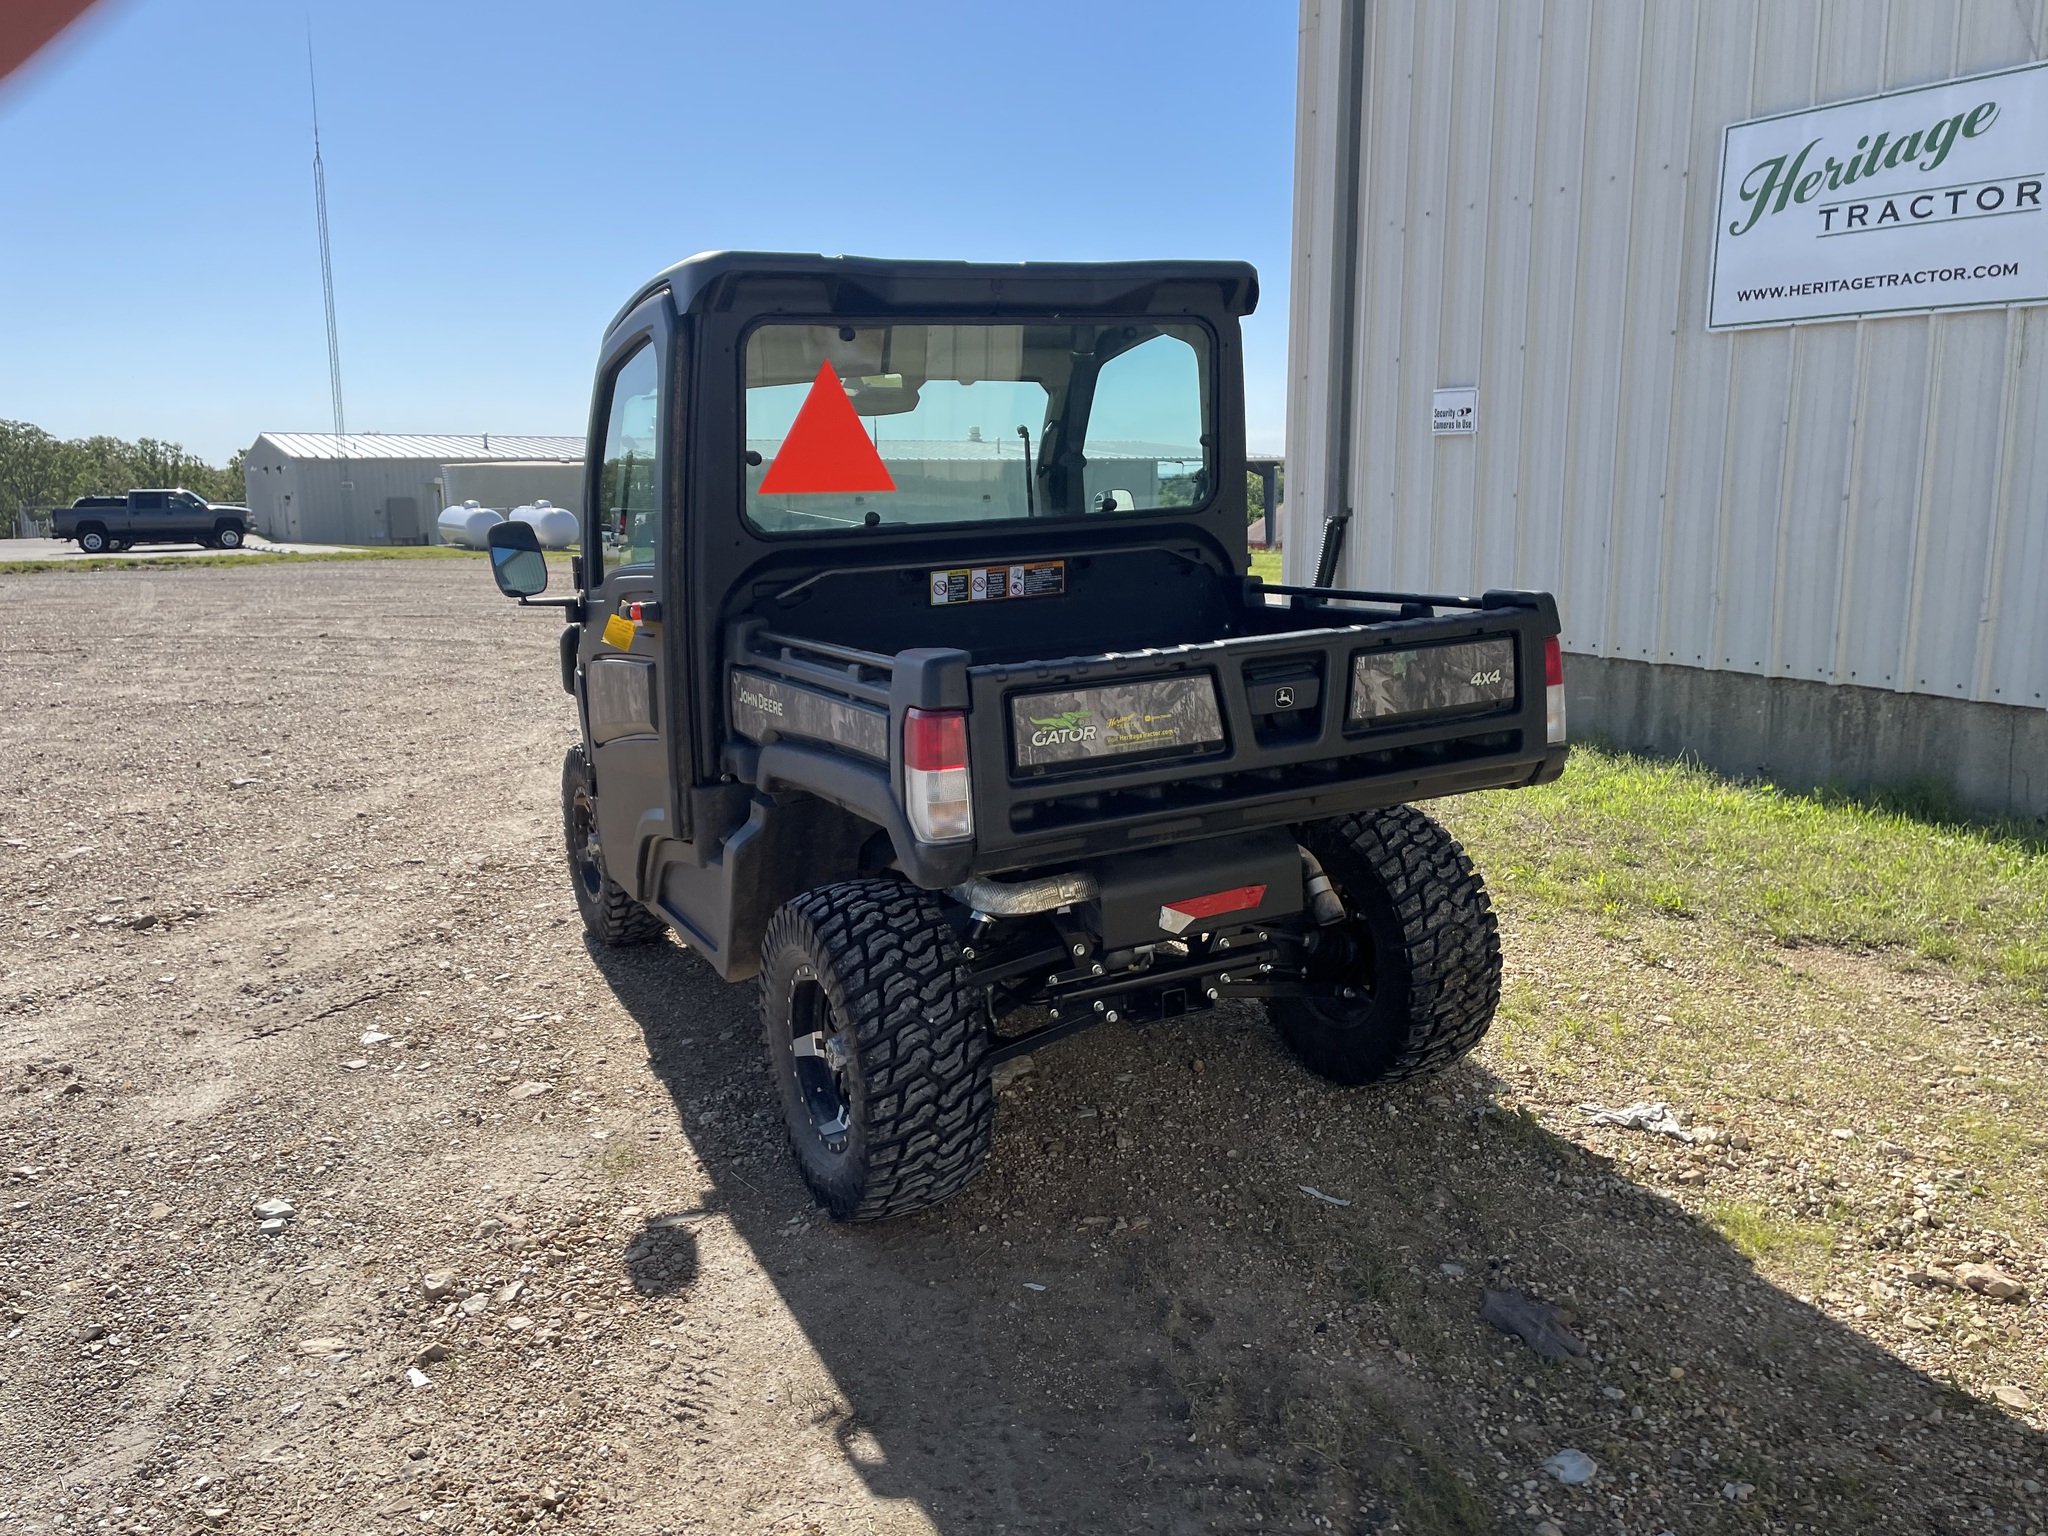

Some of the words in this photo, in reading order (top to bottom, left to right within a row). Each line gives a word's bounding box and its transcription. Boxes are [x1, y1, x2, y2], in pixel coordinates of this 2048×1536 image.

[1729, 101, 2001, 236] Heritage
[1819, 181, 2042, 231] TRACTOR
[1737, 263, 2019, 302] WWW.HERITAGETRACTOR.COM
[1433, 420, 1454, 429] Cameras
[1455, 419, 1461, 429] In
[1462, 419, 1472, 429] Use
[1434, 408, 1455, 419] Security
[739, 687, 758, 708] JOHN
[758, 693, 783, 717] DEERE
[1031, 725, 1097, 747] GATOR
